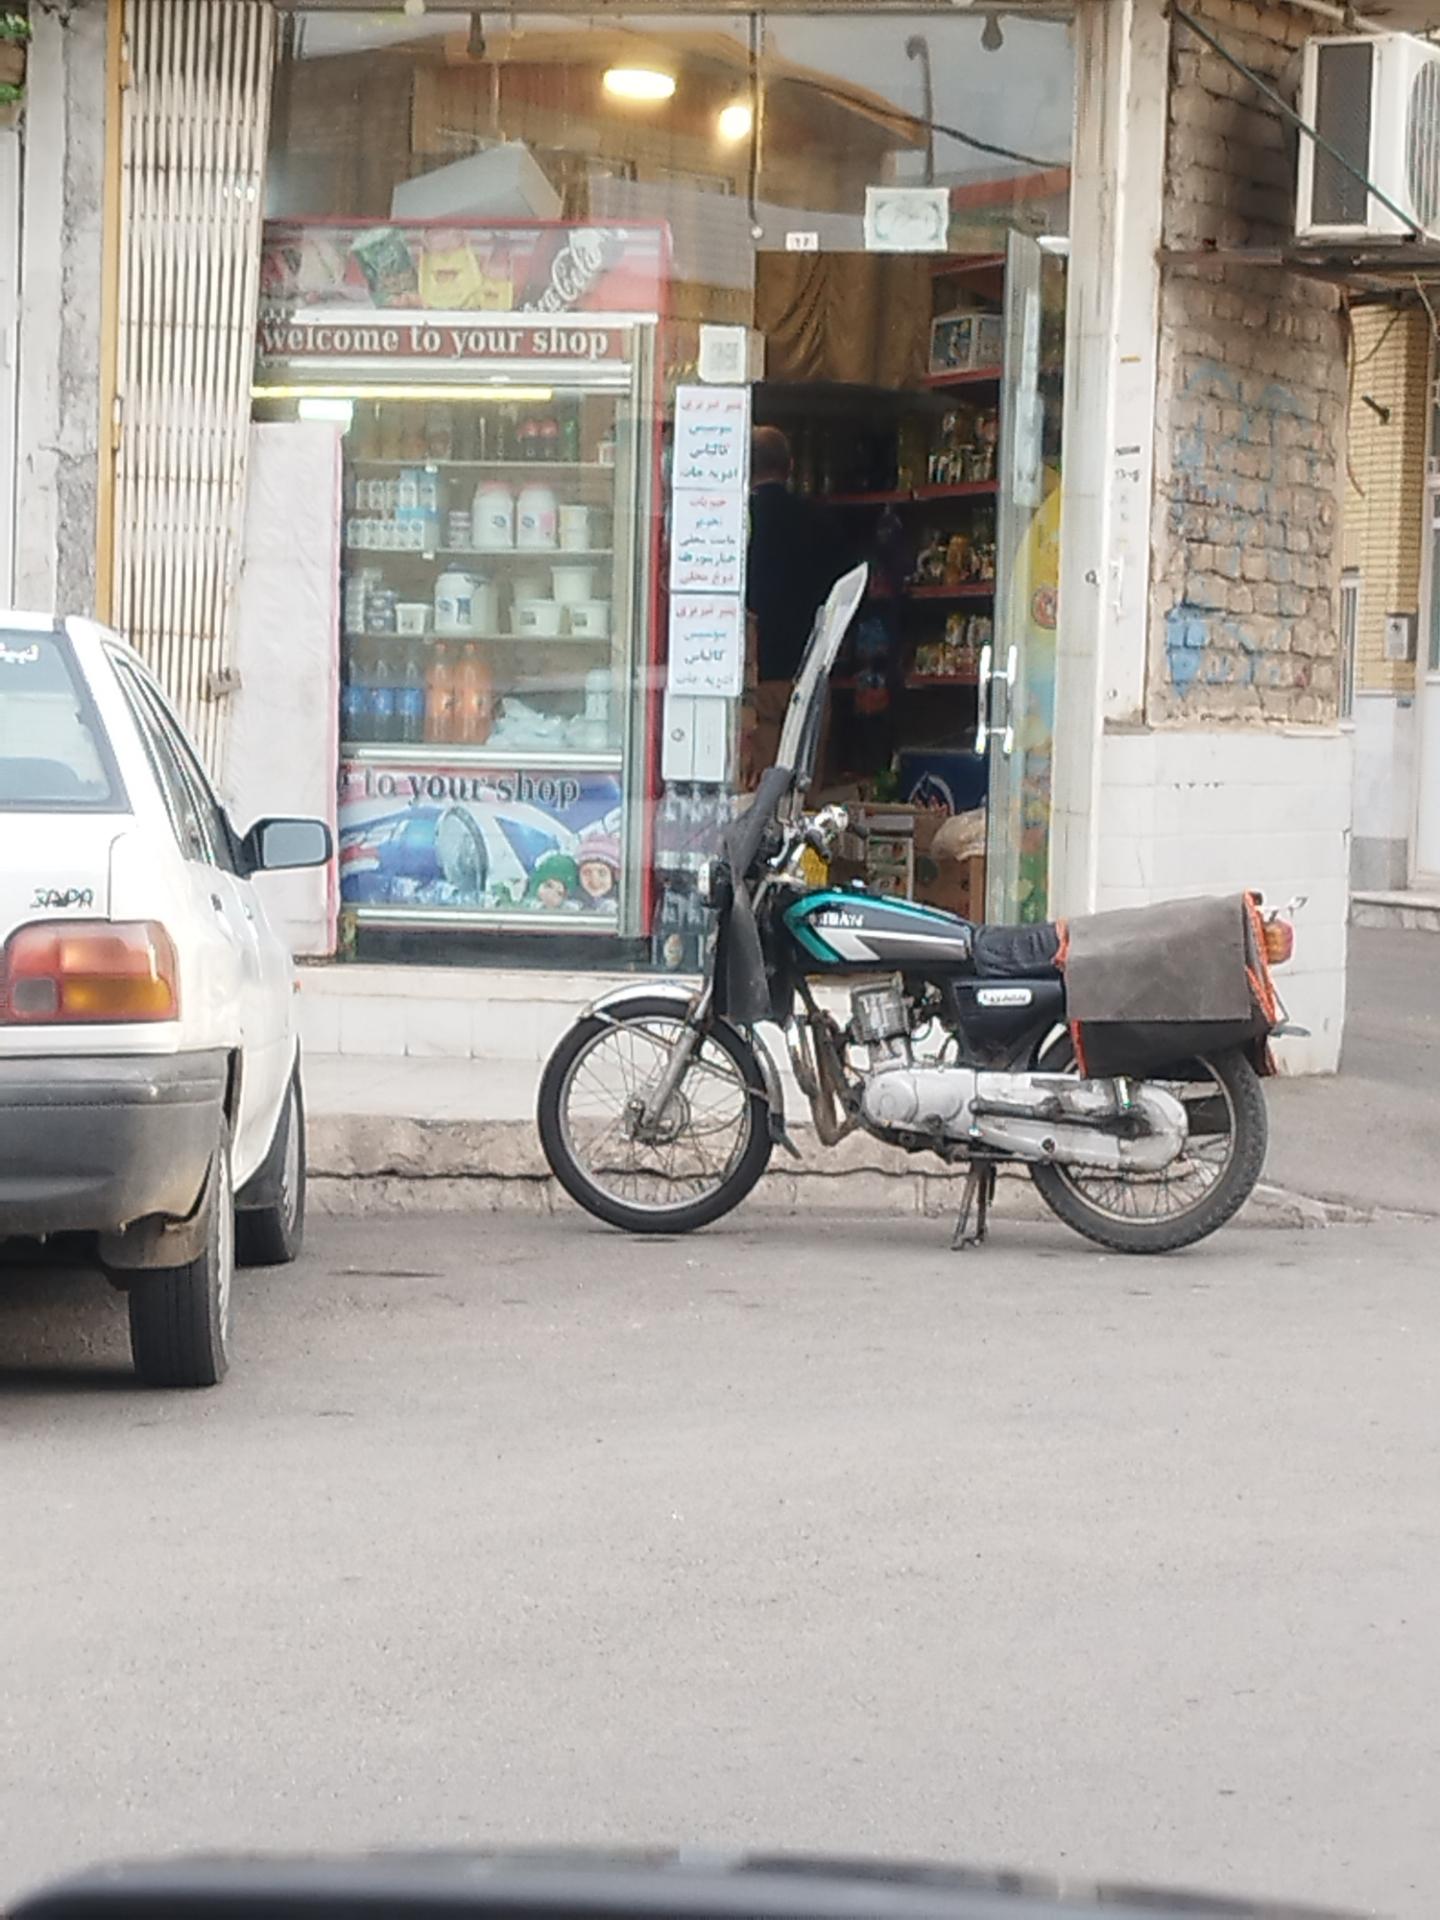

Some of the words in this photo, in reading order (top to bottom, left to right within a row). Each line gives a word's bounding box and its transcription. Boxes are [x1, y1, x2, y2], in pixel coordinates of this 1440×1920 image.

[262, 326, 398, 353] welcome
[410, 326, 441, 352] to
[451, 328, 524, 359] your
[533, 326, 609, 361] shop
[407, 774, 489, 806] your
[496, 769, 579, 809] shop
